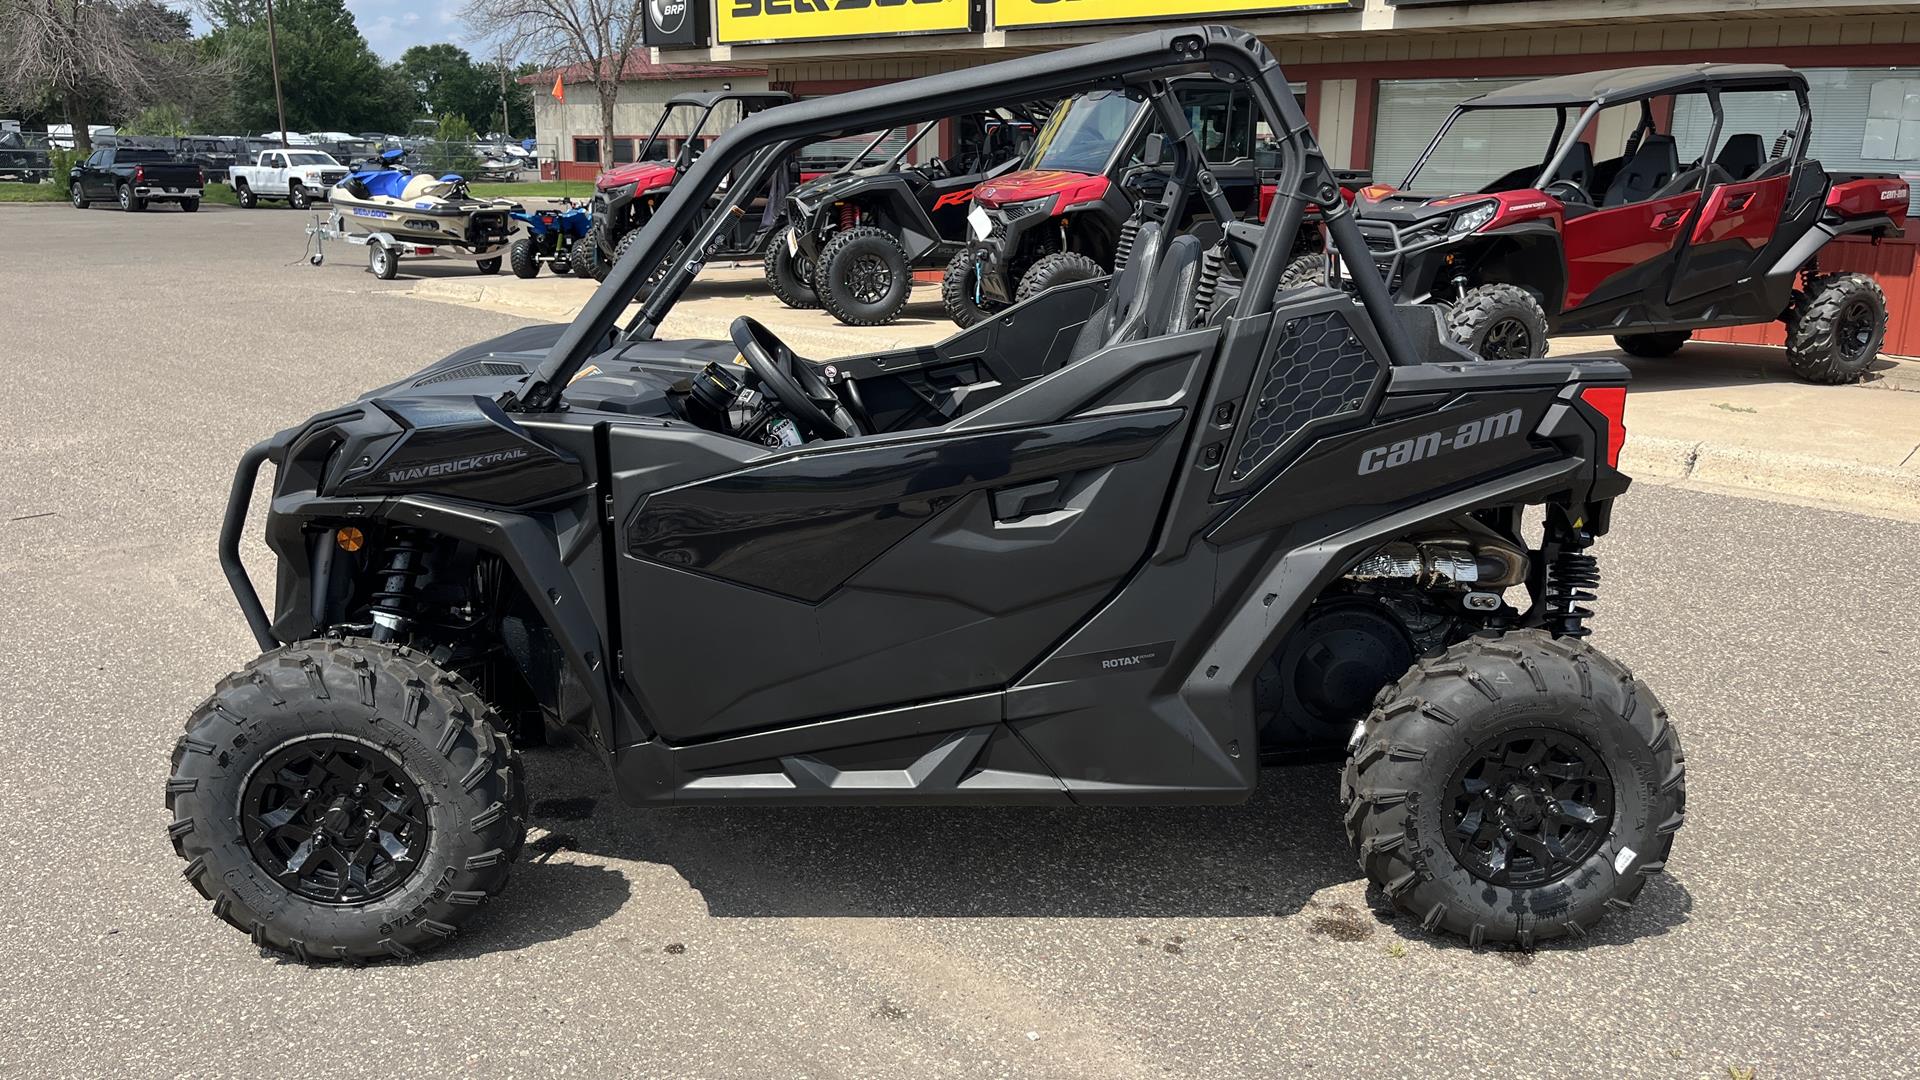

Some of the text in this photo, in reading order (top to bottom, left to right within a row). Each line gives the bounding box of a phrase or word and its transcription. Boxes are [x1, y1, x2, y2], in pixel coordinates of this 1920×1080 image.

[664, 3, 684, 15] BRP
[1880, 189, 1906, 200] can-am
[1357, 408, 1523, 476] can-am
[388, 448, 530, 482] MAVERICK TRAIL
[1101, 655, 1141, 669] ROTAX
